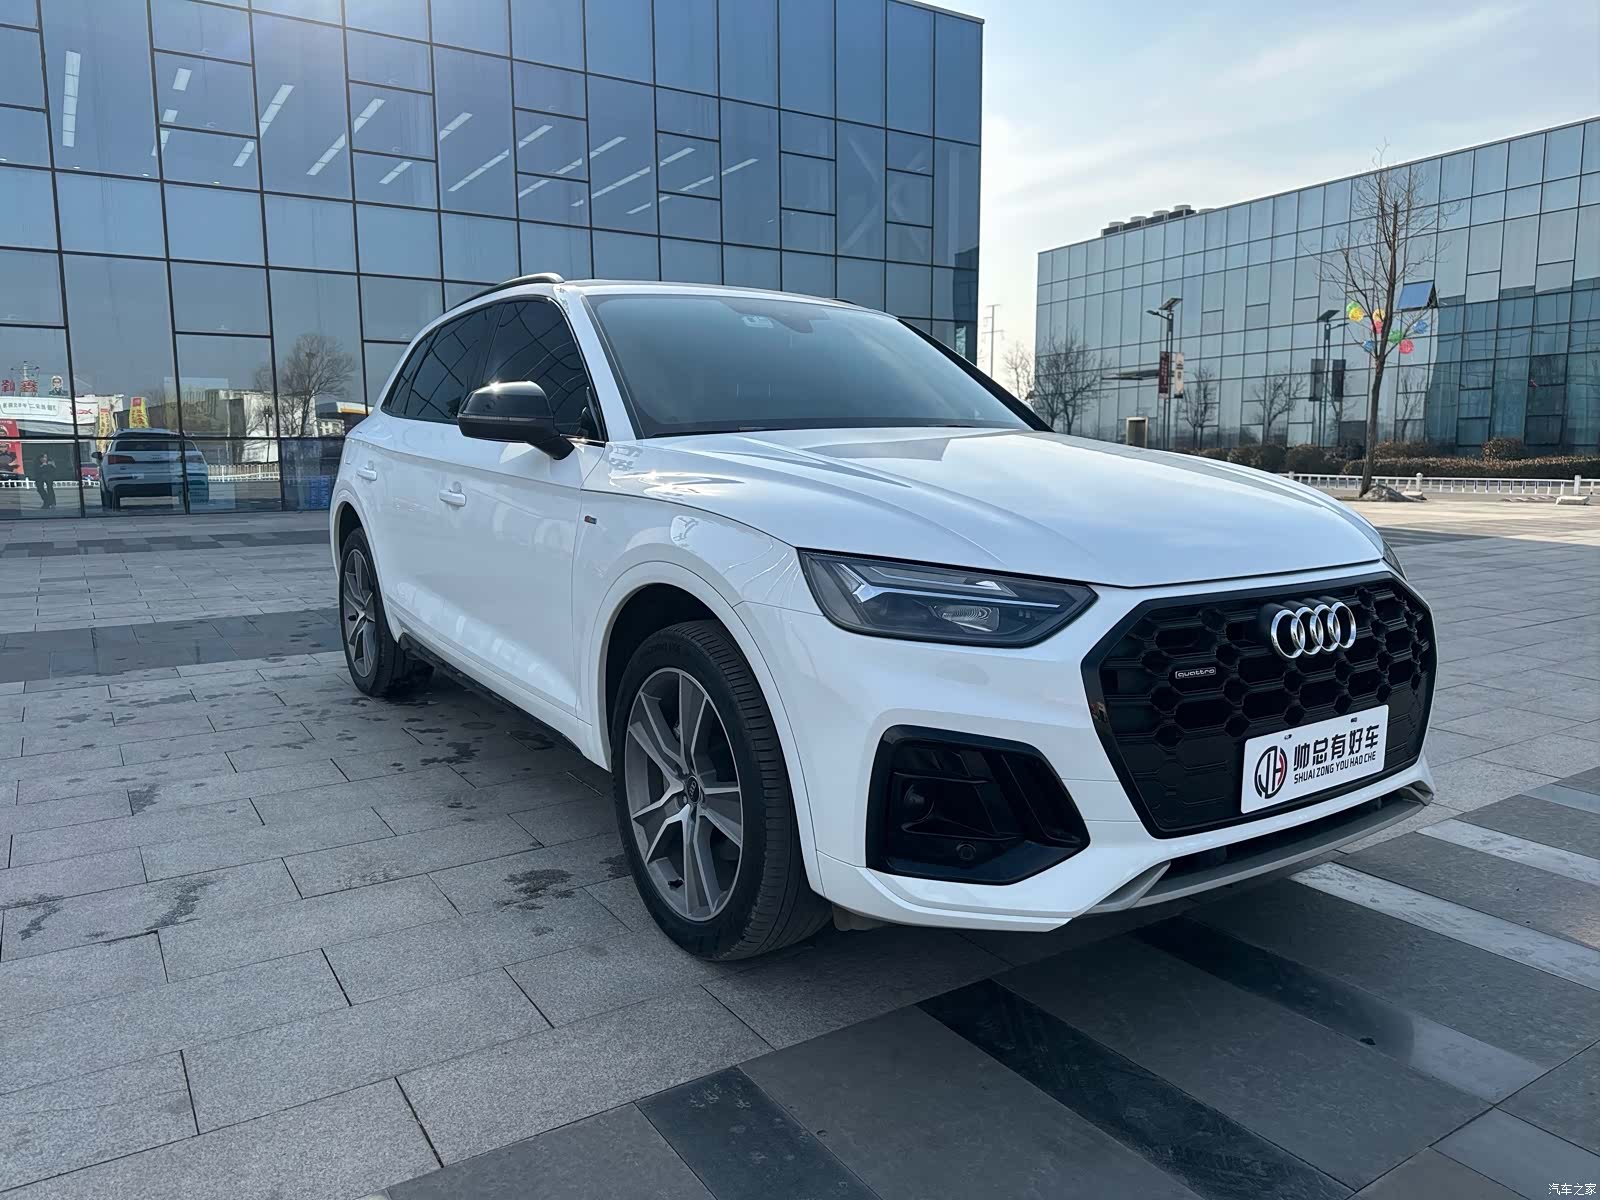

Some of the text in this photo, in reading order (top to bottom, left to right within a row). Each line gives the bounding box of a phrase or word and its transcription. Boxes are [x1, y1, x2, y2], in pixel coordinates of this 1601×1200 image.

[1178, 669, 1215, 678] quattro
[1293, 724, 1380, 772] 帅总有好车
[1293, 751, 1376, 785] SHUAI ZONG YOU HAO CHE
